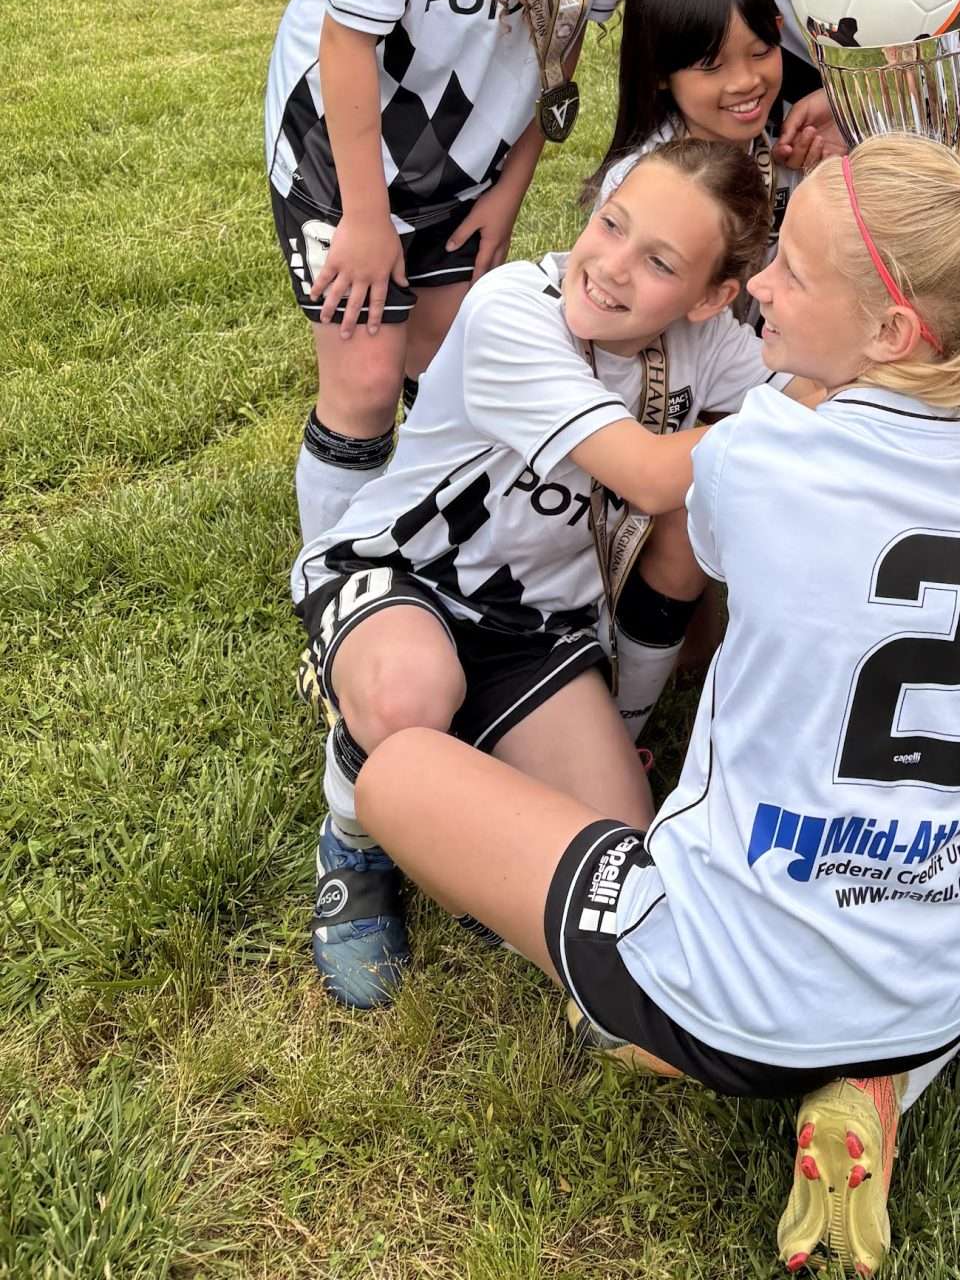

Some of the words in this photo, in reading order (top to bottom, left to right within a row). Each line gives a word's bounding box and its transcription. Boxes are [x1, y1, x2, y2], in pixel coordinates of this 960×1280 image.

[645, 347, 665, 427] CHAM
[669, 394, 686, 406] MAC
[502, 466, 592, 527] POT
[611, 516, 651, 576] VIRGINIAN
[587, 855, 609, 902] SPORT
[592, 835, 640, 905] capelli
[815, 859, 892, 880] Federal
[897, 853, 944, 885] Credit
